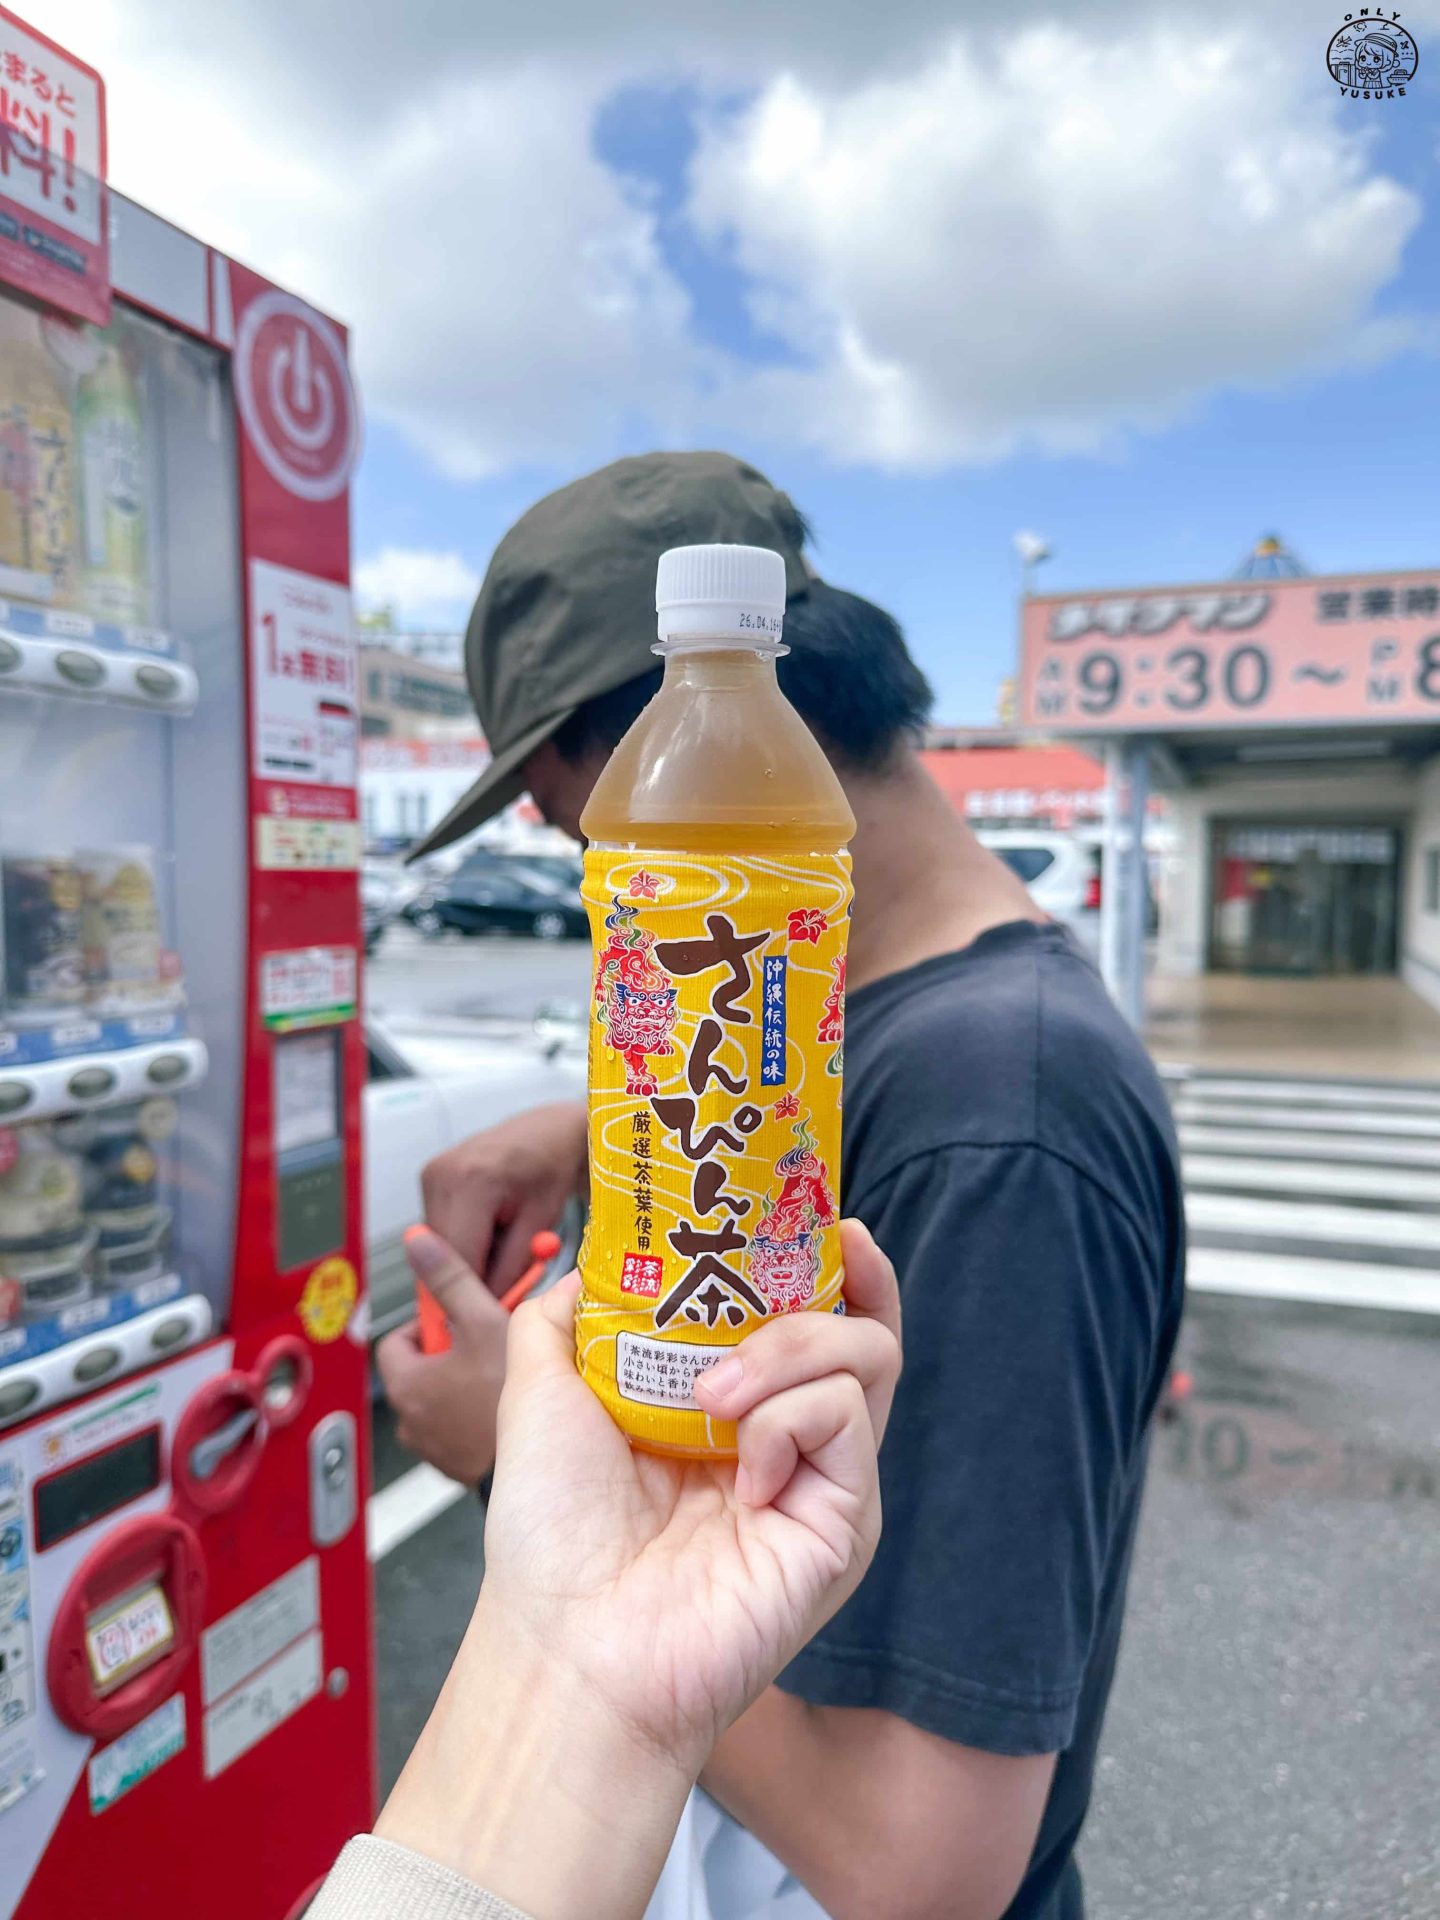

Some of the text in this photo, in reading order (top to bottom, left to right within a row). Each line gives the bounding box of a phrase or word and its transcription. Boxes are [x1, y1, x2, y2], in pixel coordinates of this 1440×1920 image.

[0, 50, 77, 119] まると
[1078, 643, 1272, 716] 9:30
[762, 958, 785, 1082] 沖縄伝統の味
[650, 913, 772, 1329] さんぴん茶
[632, 1110, 654, 1252] 厳選茶葉使用
[623, 1368, 695, 1391] 味わいと香り
[624, 1382, 696, 1401] 飲みやすいジ
